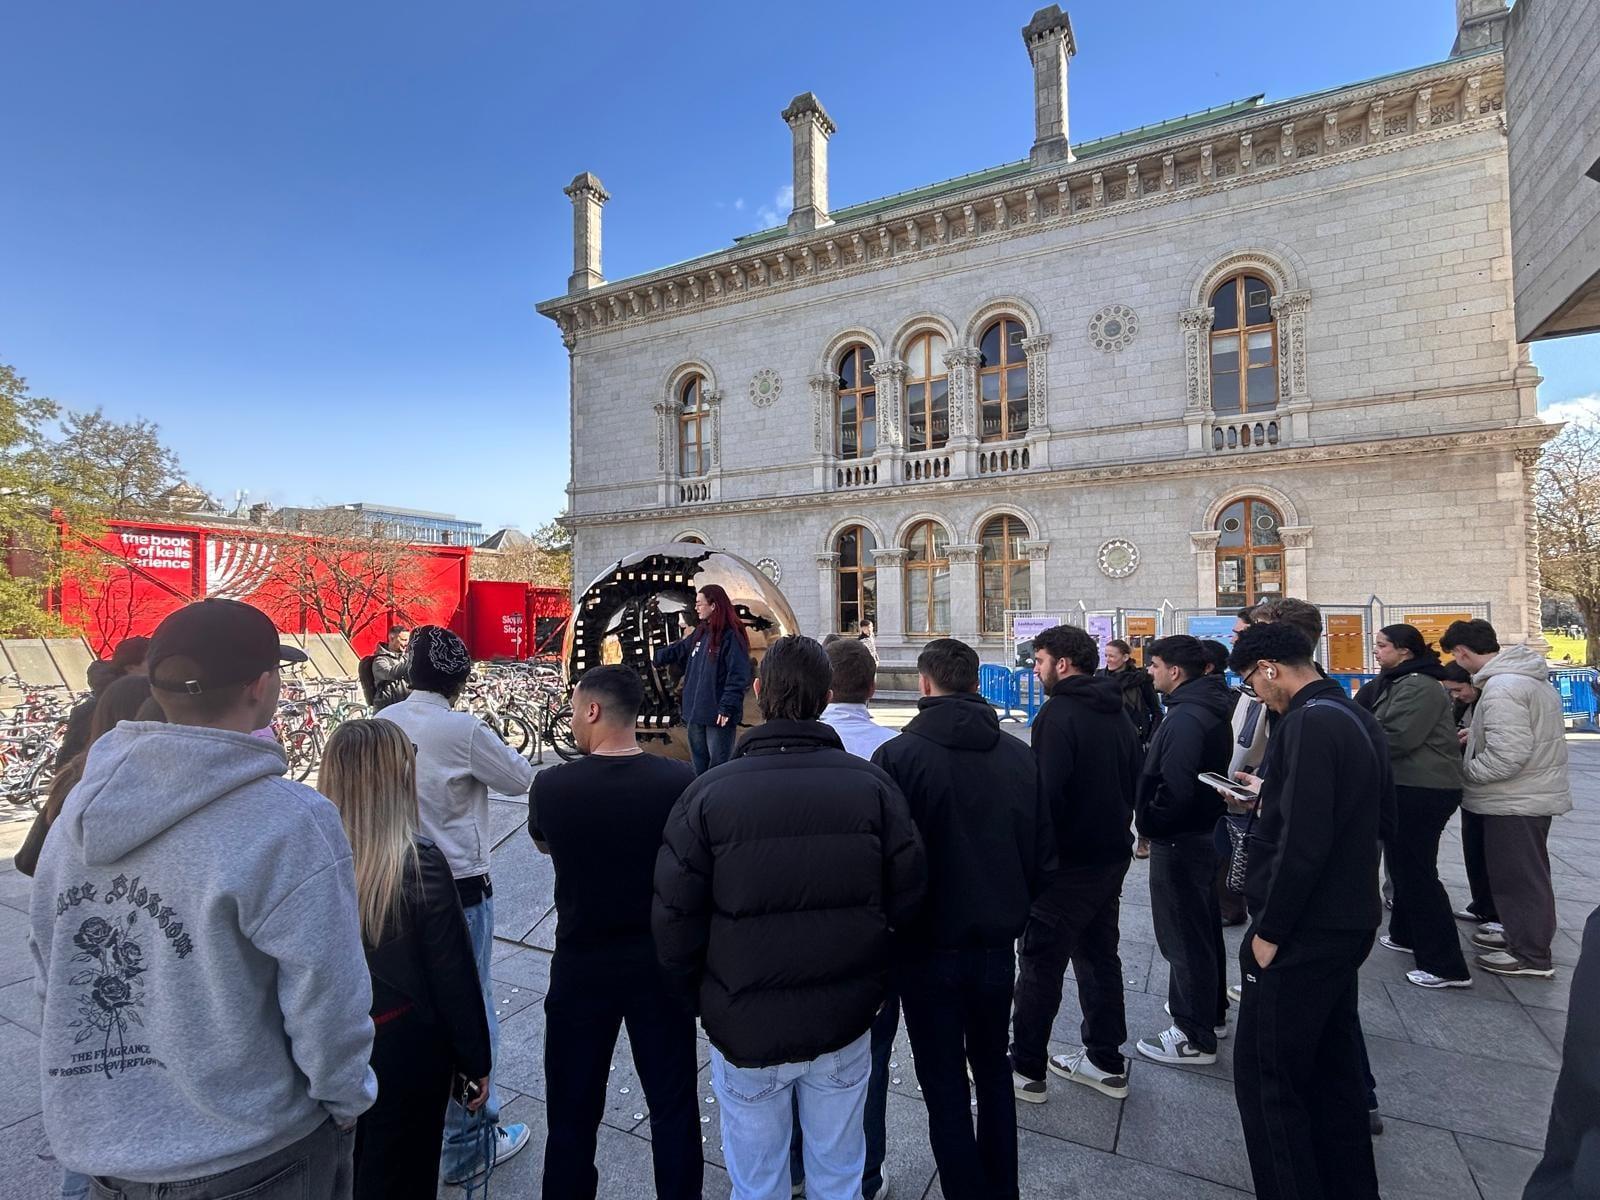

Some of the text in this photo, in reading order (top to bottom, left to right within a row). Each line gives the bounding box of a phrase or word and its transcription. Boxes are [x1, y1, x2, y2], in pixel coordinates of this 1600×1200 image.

[121, 533, 190, 546] the book
[138, 546, 190, 558] of kells
[102, 555, 190, 569] erience
[504, 624, 522, 633] Shop
[104, 873, 194, 960] Blossom
[71, 1045, 150, 1062] THE FRAGRANCE
[60, 1065, 92, 1076] ROSES
[94, 1063, 105, 1073] IS
